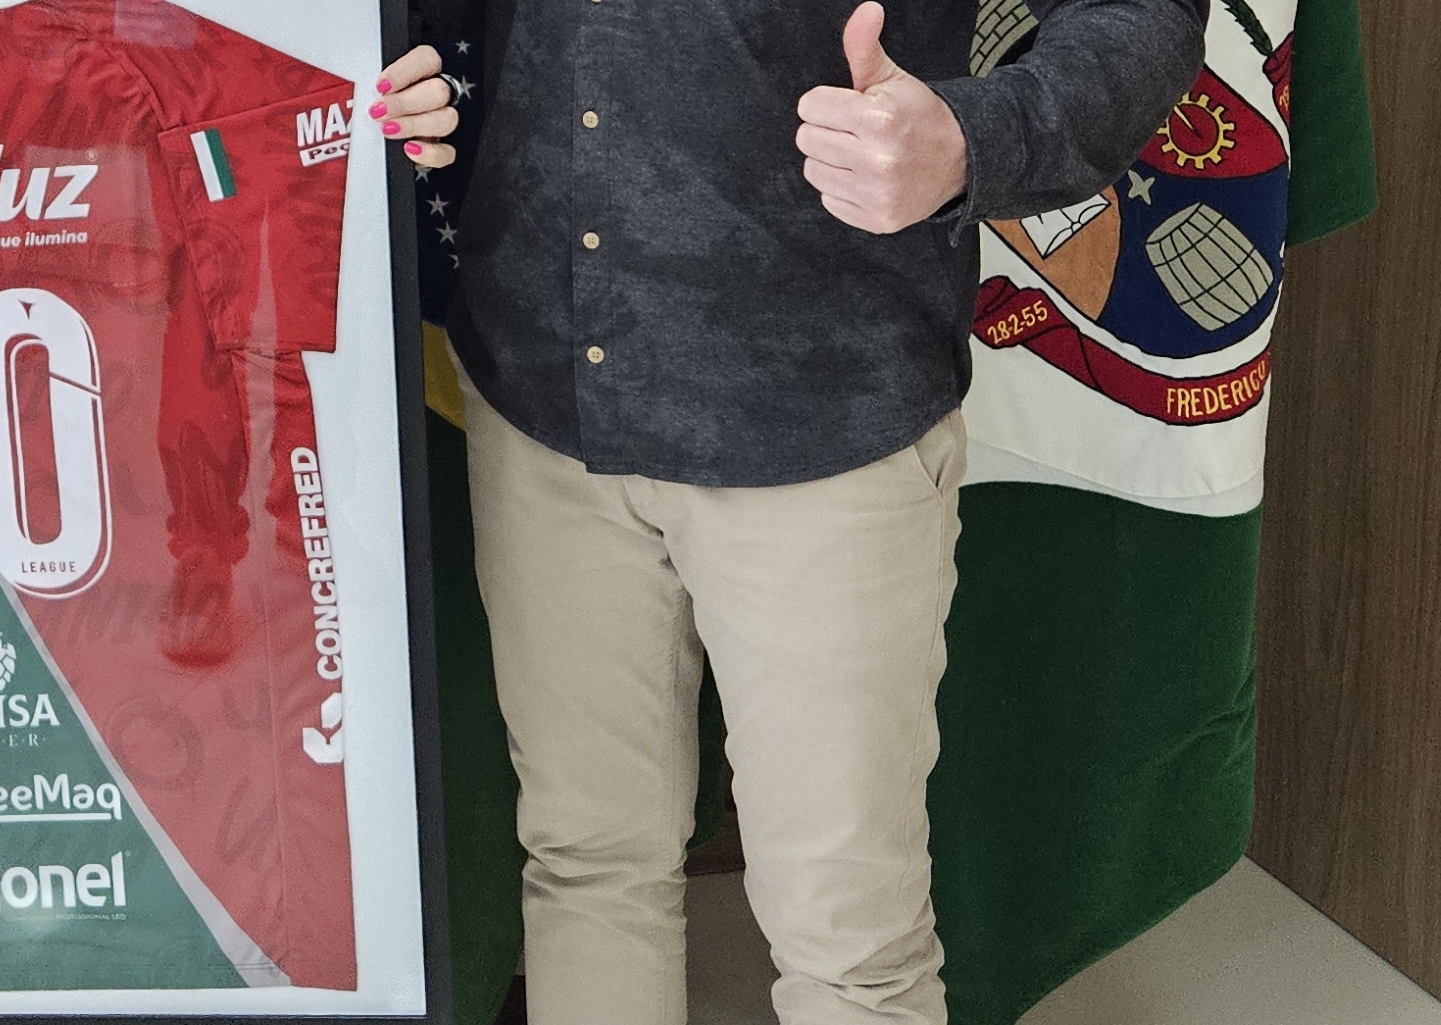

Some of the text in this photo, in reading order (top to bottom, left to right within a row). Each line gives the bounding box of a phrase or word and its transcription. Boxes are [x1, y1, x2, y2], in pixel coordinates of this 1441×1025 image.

[25, 230, 88, 246] ilumina
[987, 300, 1048, 344] 28-2-55
[21, 561, 77, 573] LEAGUE
[290, 446, 344, 680] CONCREFRED
